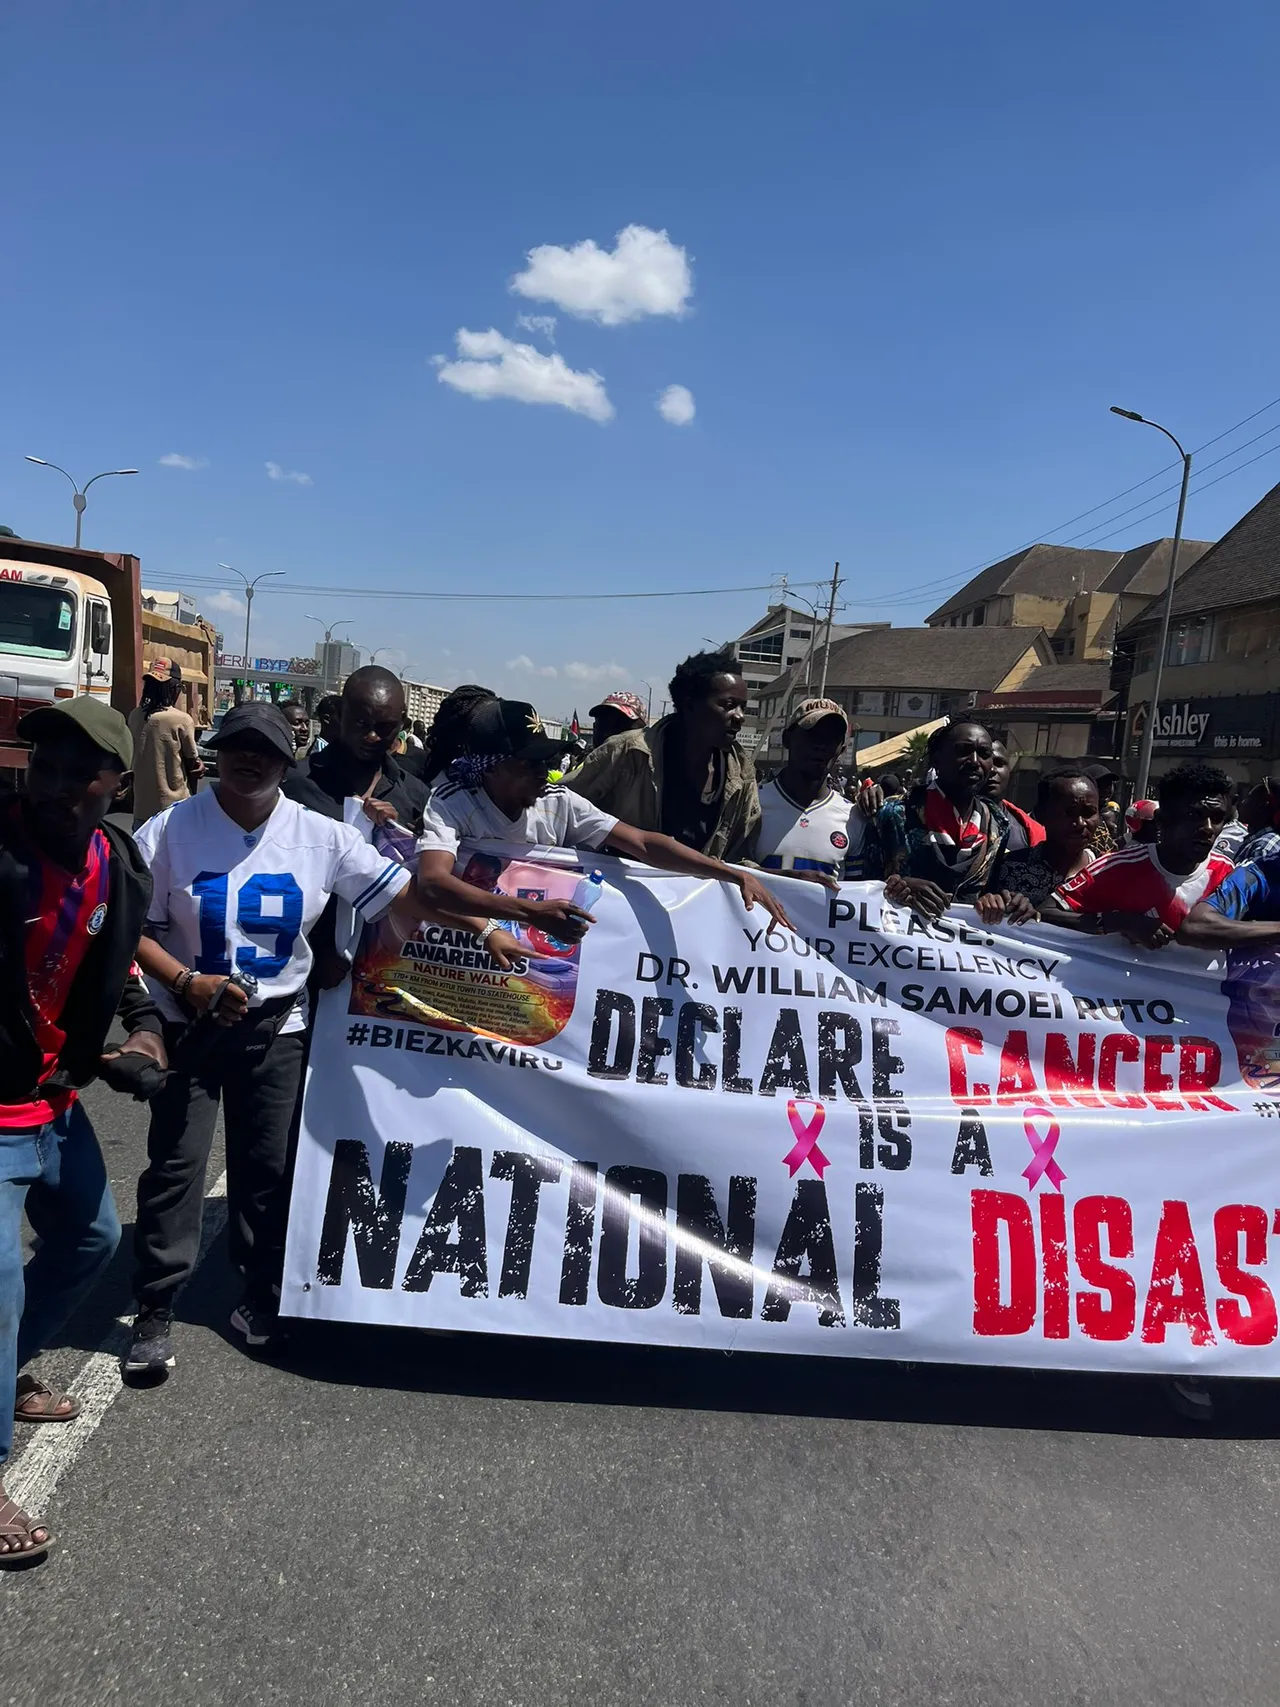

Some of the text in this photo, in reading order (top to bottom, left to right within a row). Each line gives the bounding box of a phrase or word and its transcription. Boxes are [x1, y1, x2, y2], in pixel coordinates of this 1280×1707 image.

[1152, 703, 1210, 742] Ashley
[1214, 736, 1228, 748] this
[1229, 736, 1237, 748] is
[192, 870, 304, 978] 19
[413, 961, 510, 988] NATURE WALK
[742, 928, 1061, 981] YOUR EXCELLENCY
[420, 976, 438, 987] FROM
[439, 982, 456, 990] KITUI
[457, 985, 476, 994] TOWN
[477, 988, 486, 996] TO
[487, 990, 531, 1002] STATEHOUSE
[636, 952, 1176, 1026] DR. WILLIAM SAMOEI RUTO
[346, 1022, 563, 1072] #BIEZKAVIRU
[587, 988, 1241, 1113] DECLARE CANCER
[858, 1105, 995, 1177] IS A
[316, 1138, 1280, 1347] NATIONAL DISAS
